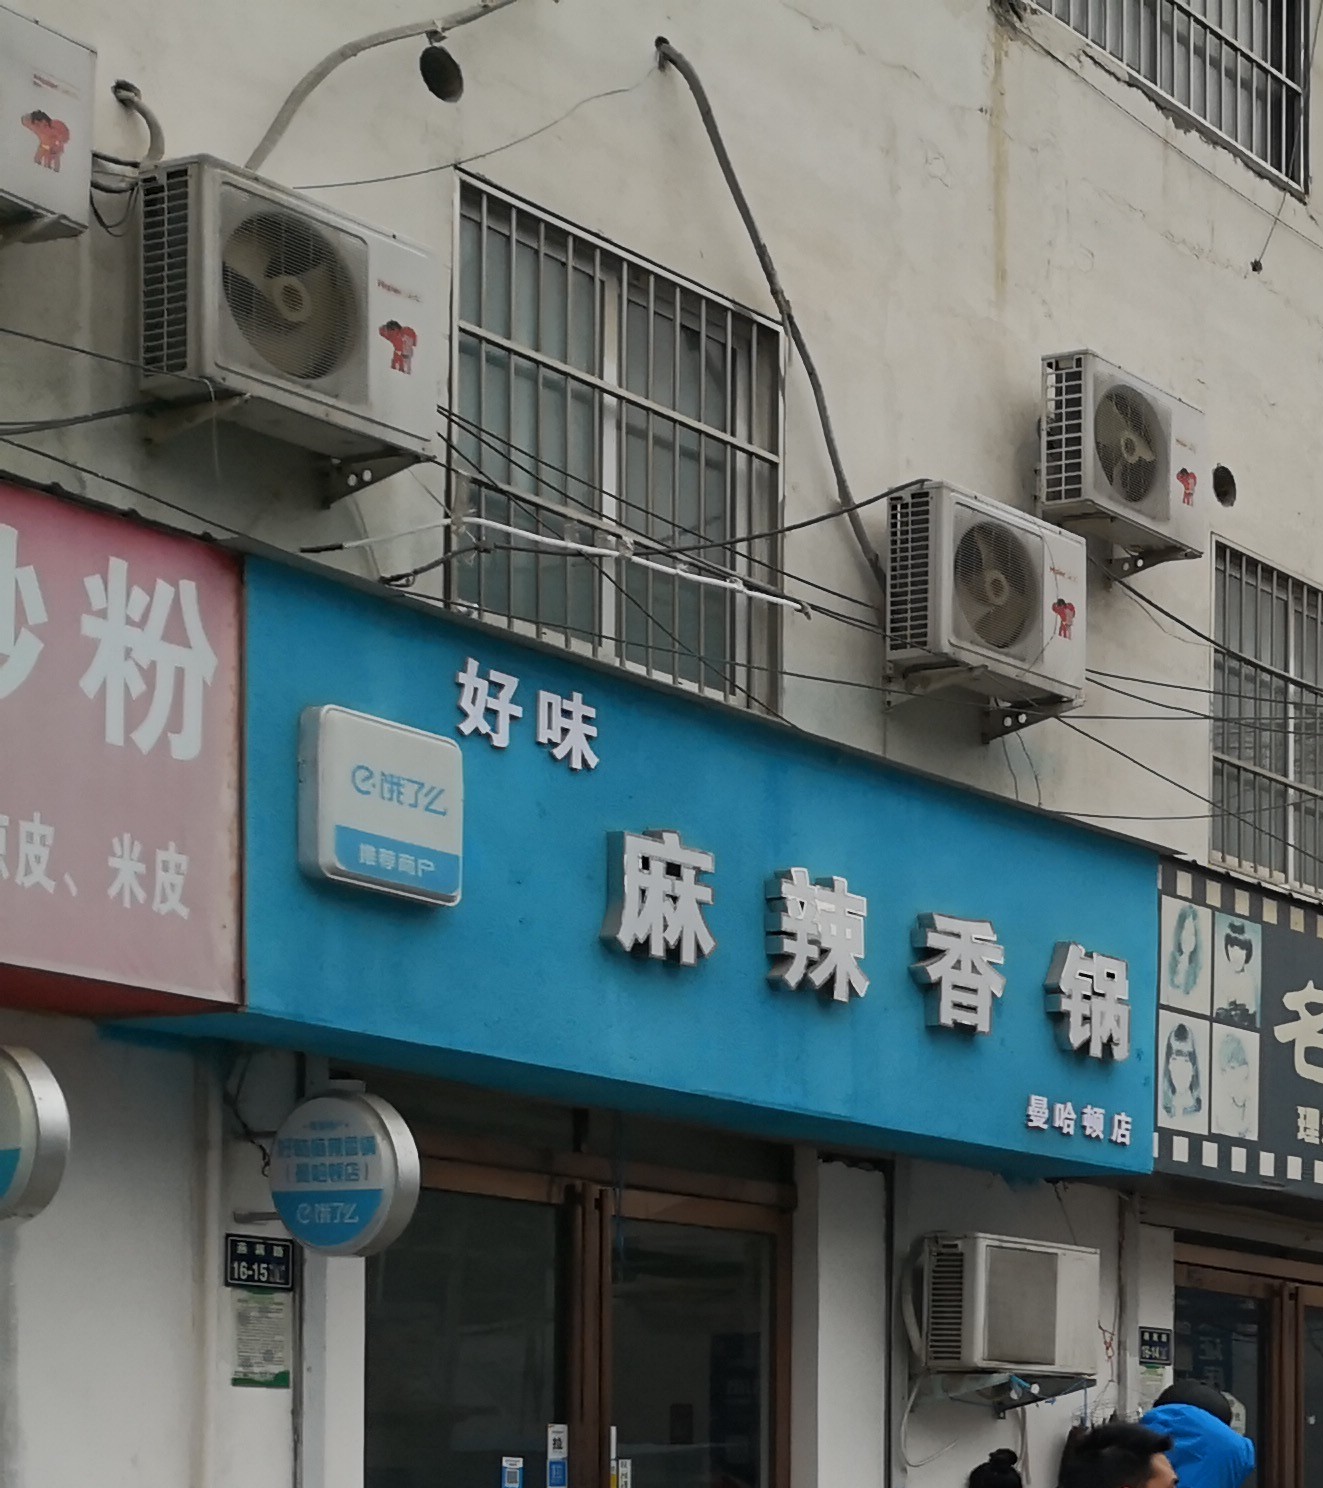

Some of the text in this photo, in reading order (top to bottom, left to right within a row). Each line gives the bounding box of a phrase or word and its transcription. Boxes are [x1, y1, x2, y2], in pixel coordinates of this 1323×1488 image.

[456, 657, 600, 771] 好味
[0, 811, 190, 921] 皮、米皮
[602, 829, 1131, 1062] 麻辣香锅
[1026, 1095, 1131, 1146] 曼哈顿店
